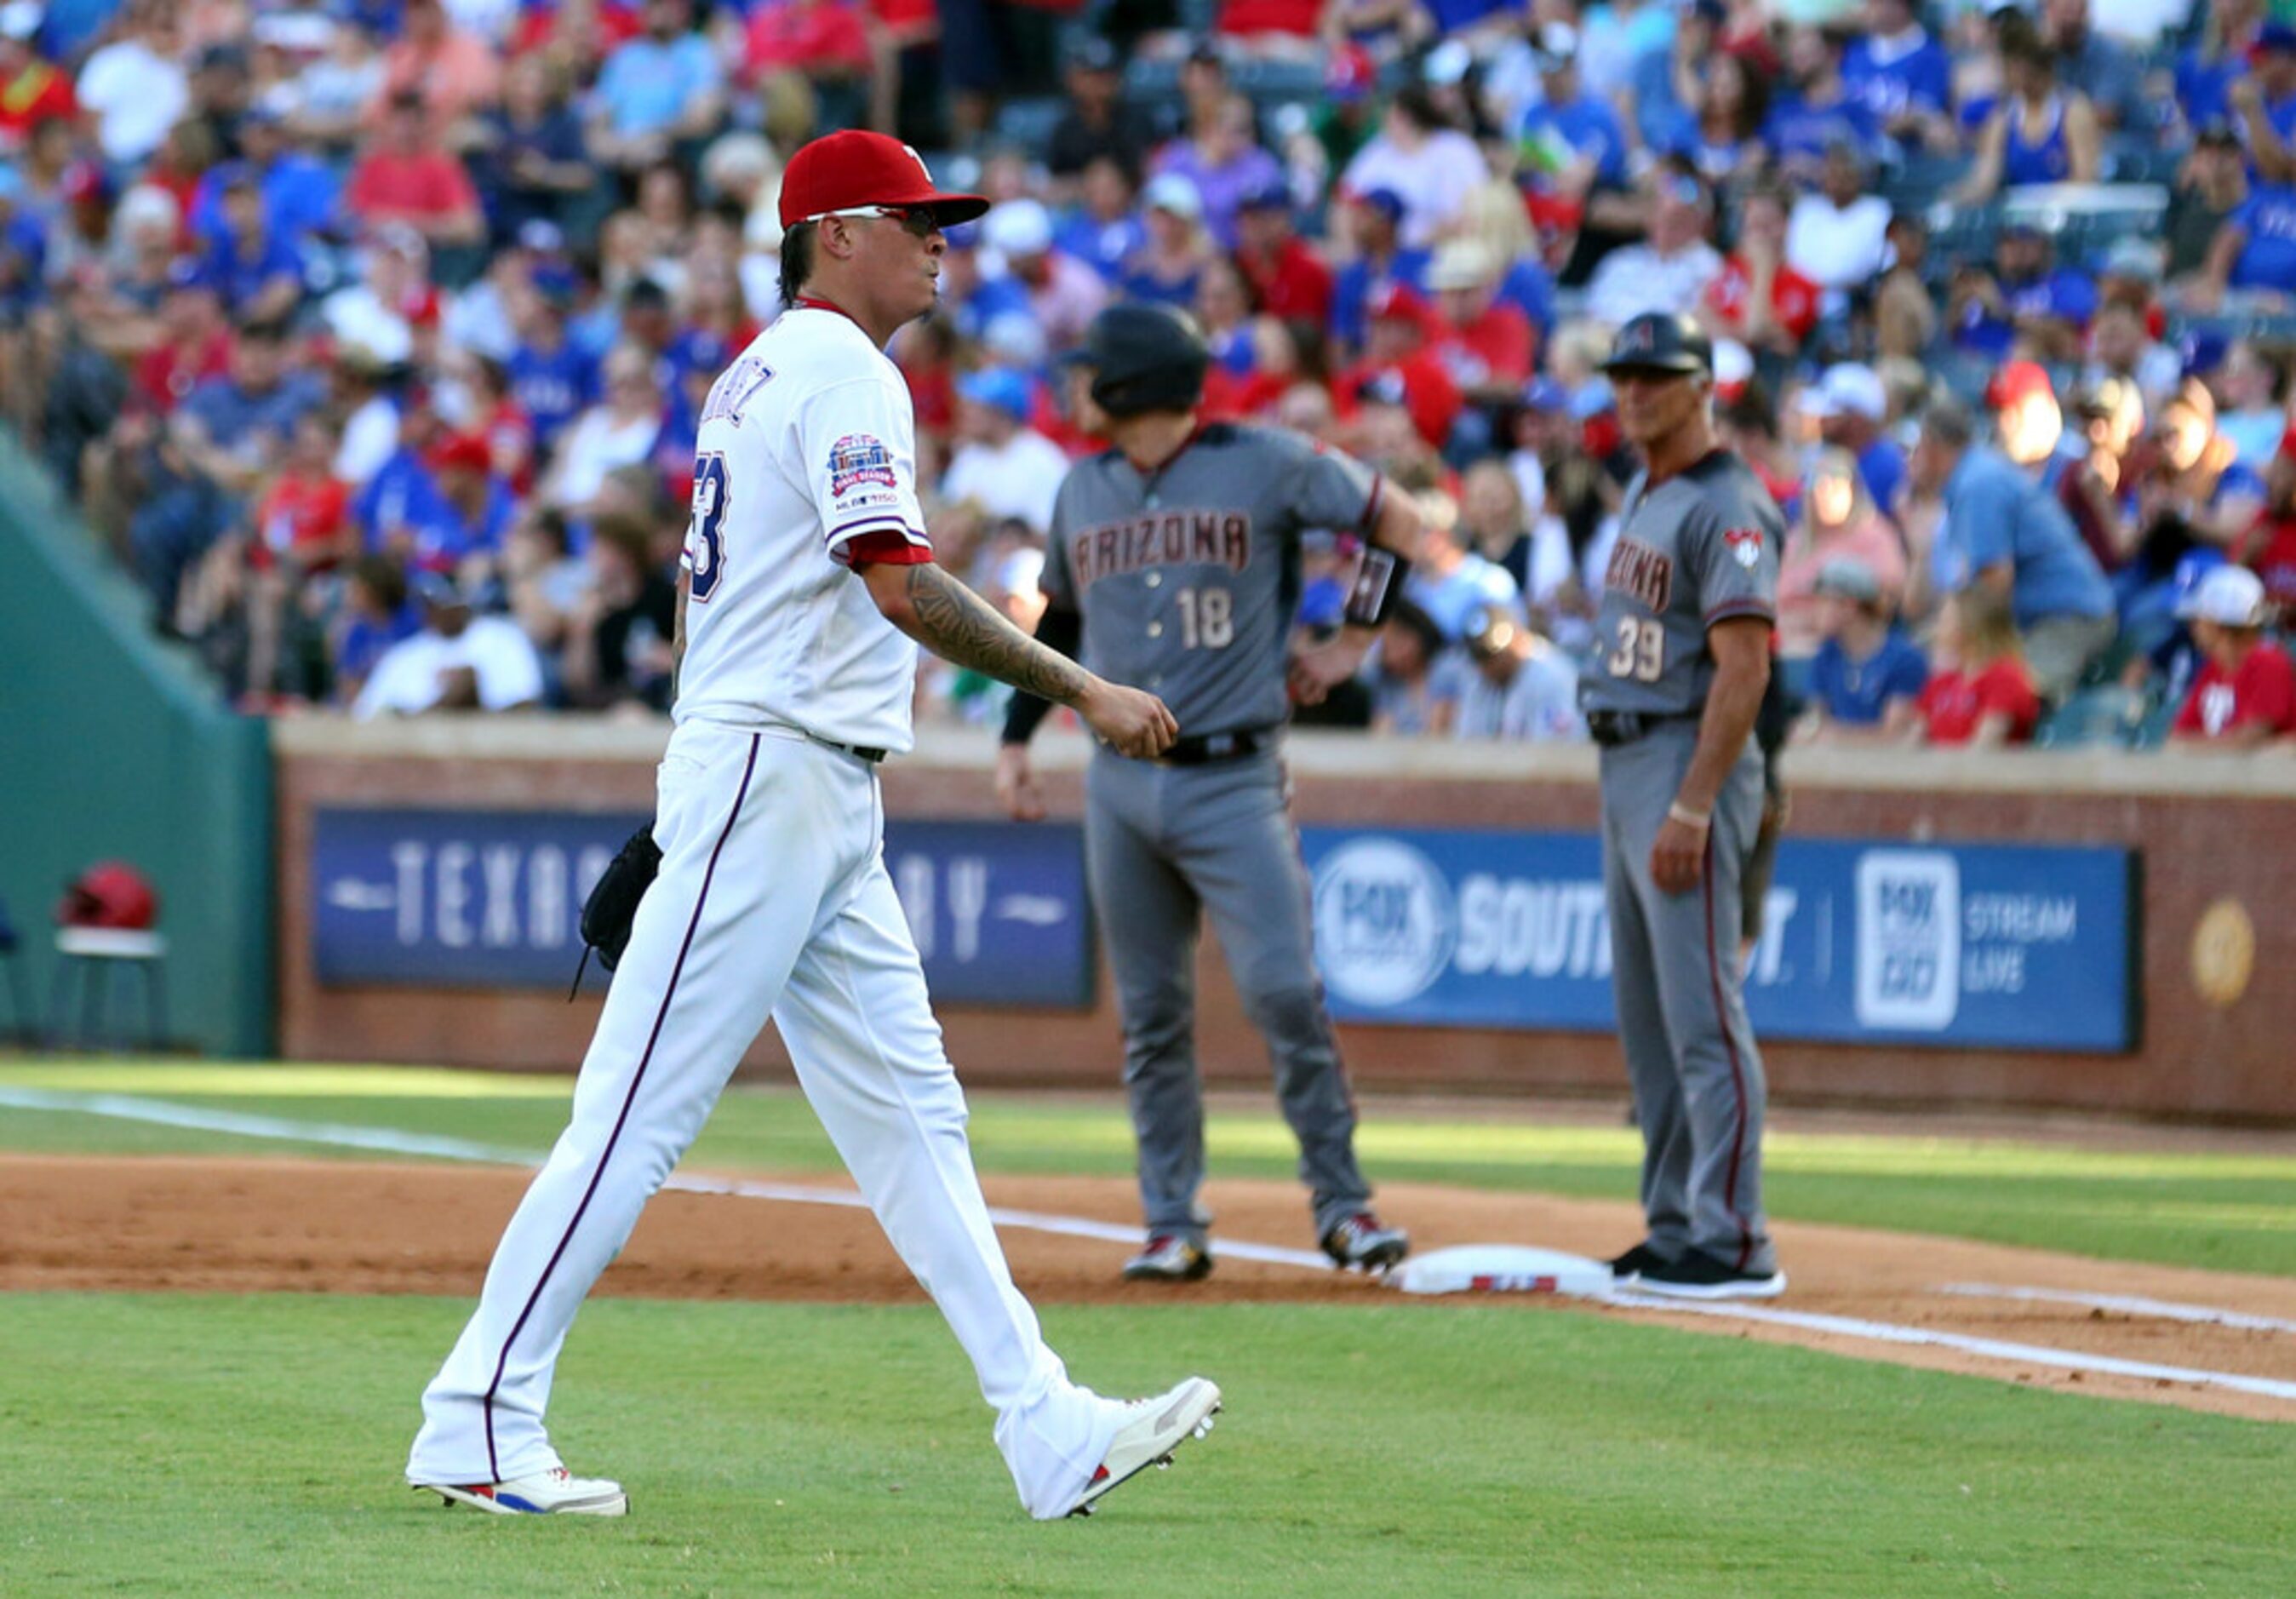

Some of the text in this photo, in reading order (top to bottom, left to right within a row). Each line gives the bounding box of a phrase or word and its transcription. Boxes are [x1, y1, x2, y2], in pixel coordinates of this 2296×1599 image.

[1072, 514, 1250, 589] ARIZONA
[1177, 589, 1234, 650] 18
[1608, 614, 1665, 681] 39
[1966, 891, 2078, 944] STREAM
[1962, 943, 2027, 994] LIVE
